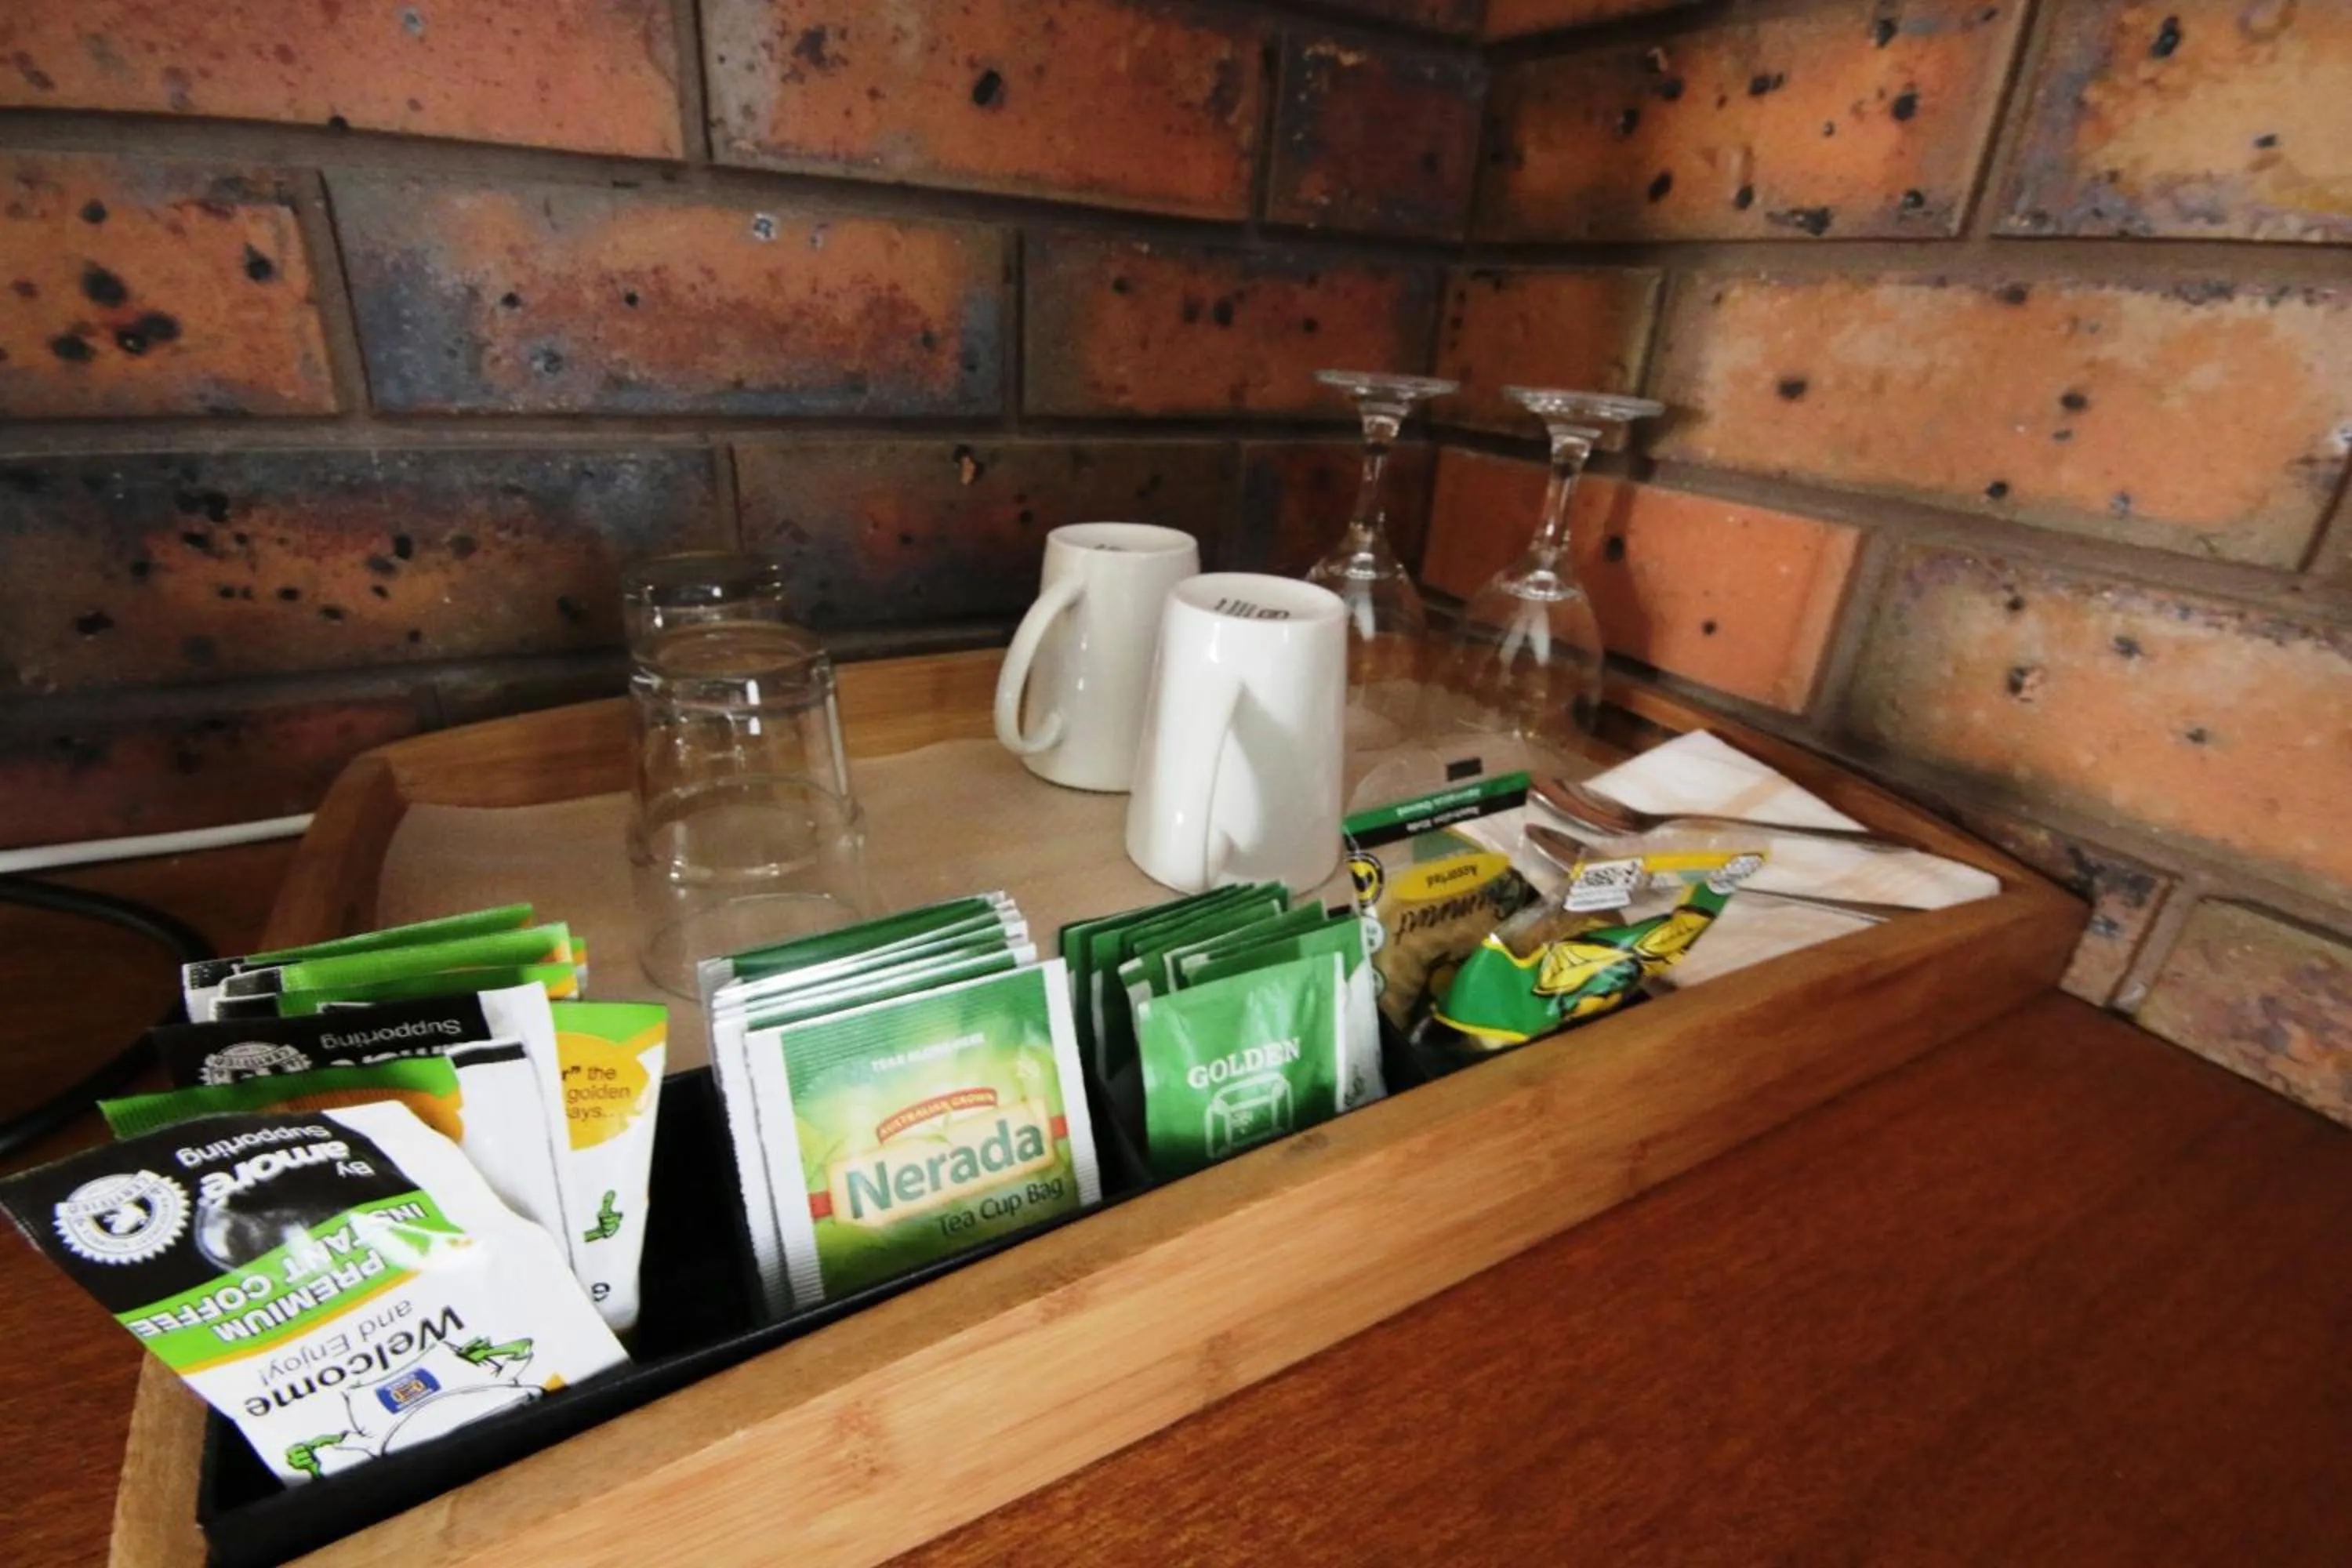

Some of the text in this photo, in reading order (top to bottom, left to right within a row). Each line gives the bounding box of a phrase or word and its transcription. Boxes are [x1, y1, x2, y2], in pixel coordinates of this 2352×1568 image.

[320, 1019, 461, 1051] Supporting
[1187, 1037, 1301, 1088] GOLDEN
[567, 1084, 630, 1104] golden
[587, 1067, 617, 1081] the
[177, 1124, 332, 1167] Supporting
[199, 1140, 350, 1201] amore
[336, 1160, 376, 1178] By
[846, 1120, 1044, 1219] Nerada
[938, 1176, 1064, 1236] Tea Cup Bag
[127, 1273, 273, 1338] COFFEE
[211, 1249, 387, 1342] PREMIUM
[245, 1305, 465, 1416] Welcome
[257, 1299, 414, 1386] and Enjoy!
